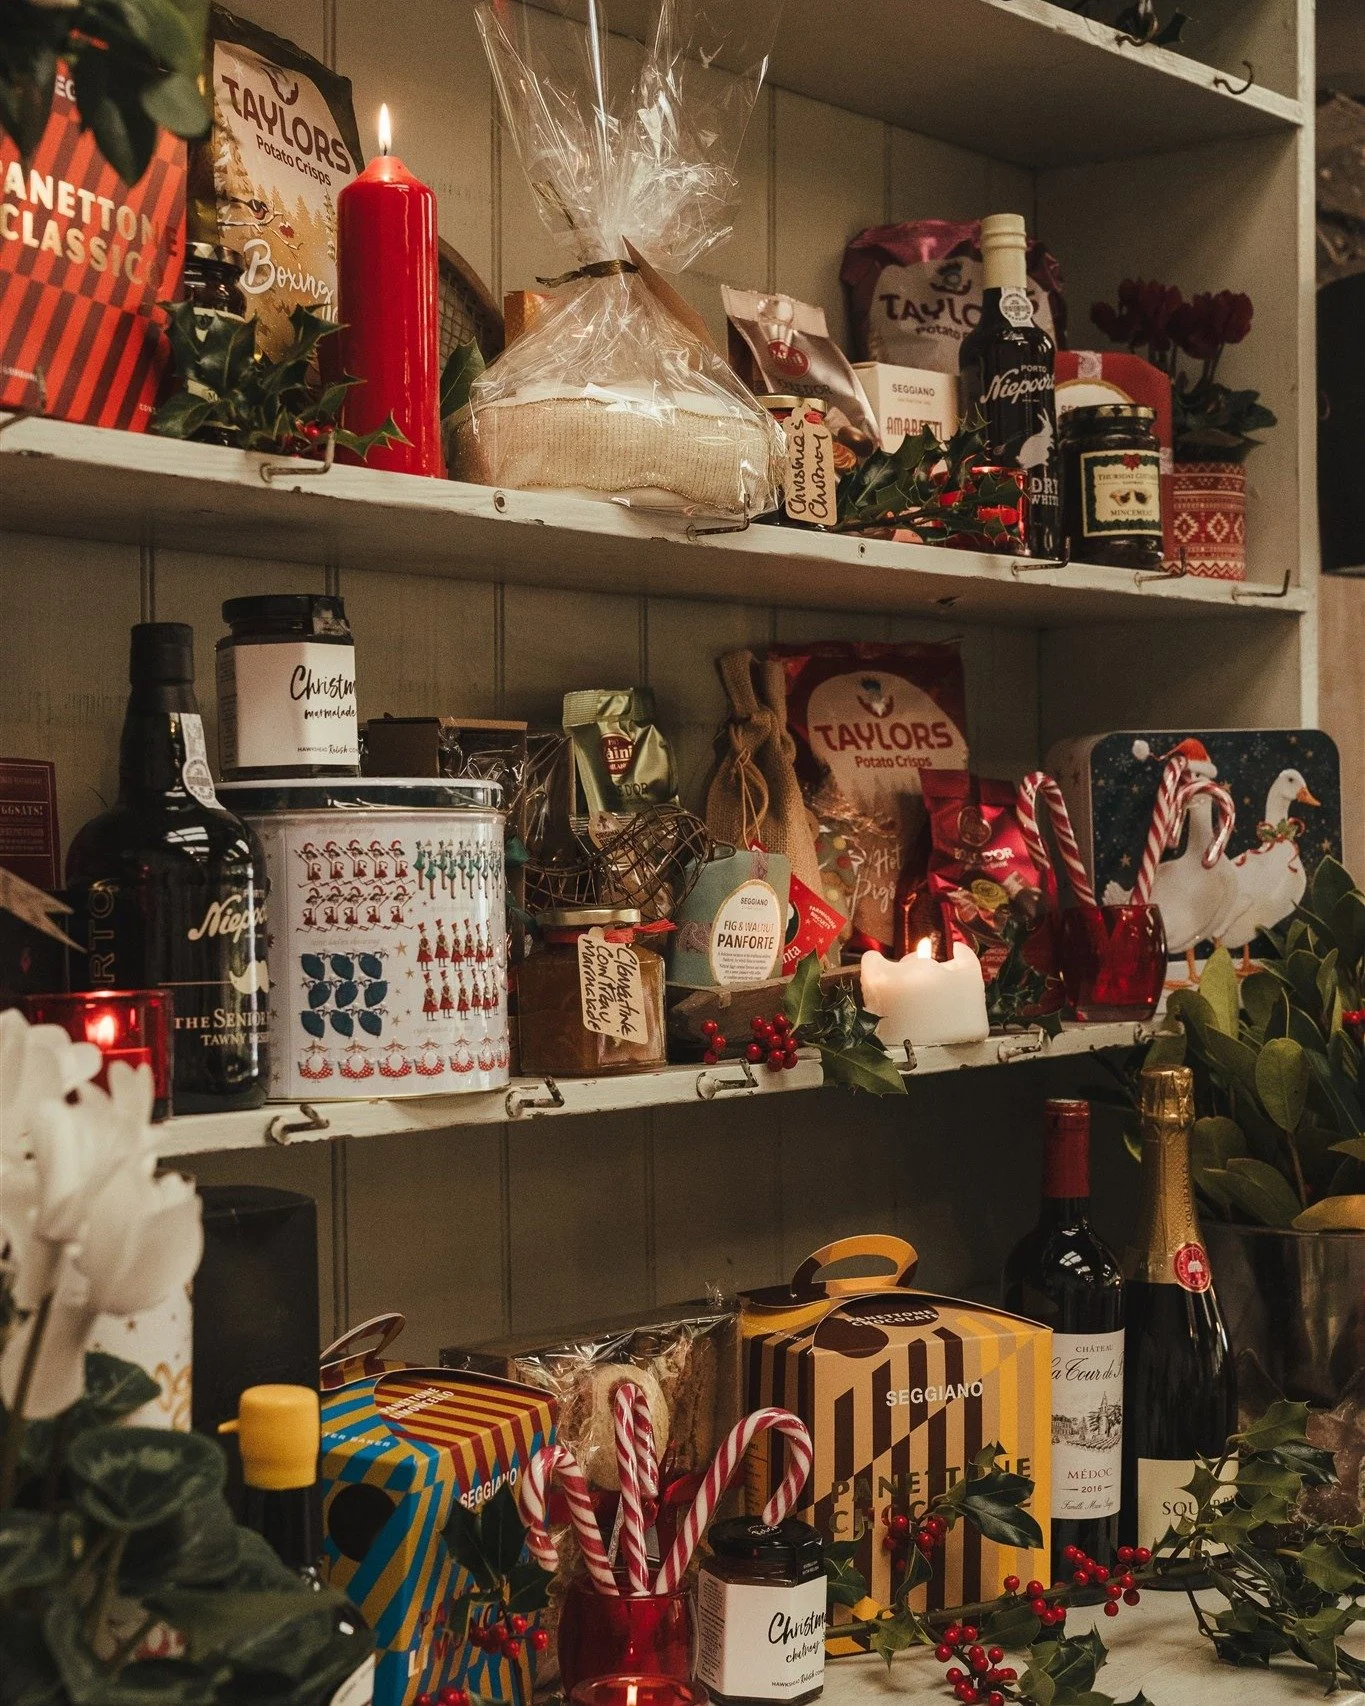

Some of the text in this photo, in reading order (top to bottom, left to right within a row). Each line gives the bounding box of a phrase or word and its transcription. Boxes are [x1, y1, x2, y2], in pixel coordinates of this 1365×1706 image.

[221, 74, 352, 175] TAYLORS
[256, 134, 332, 187] Potato Crisps
[0, 160, 178, 258] ANETTONE
[240, 238, 335, 316] Boxing
[879, 292, 983, 328] TAYLO
[1020, 364, 1047, 373] PORTO
[892, 383, 935, 397] SEGGIANO
[887, 417, 943, 440] AMARETI
[304, 705, 357, 720] marmalade
[813, 722, 954, 751] TAYLORS
[606, 745, 633, 760] aini
[855, 755, 932, 769] Potato Crisps
[740, 897, 769, 907] SEGGIANO
[724, 920, 737, 931] FIG
[88, 889, 115, 984] RTO
[717, 933, 775, 949] PANFORTE
[174, 1016, 211, 1029] THE
[200, 1032, 245, 1047] TAWNY
[844, 1309, 935, 1323] PANETTONE
[851, 1313, 939, 1327] CHOCOLATE
[1065, 1357, 1101, 1381] Tour
[886, 1381, 983, 1408] SEGGIANO
[1067, 1467, 1113, 1480] MÉDOC
[460, 1467, 518, 1510] SEGGIANO
[1081, 1484, 1103, 1494] 2016
